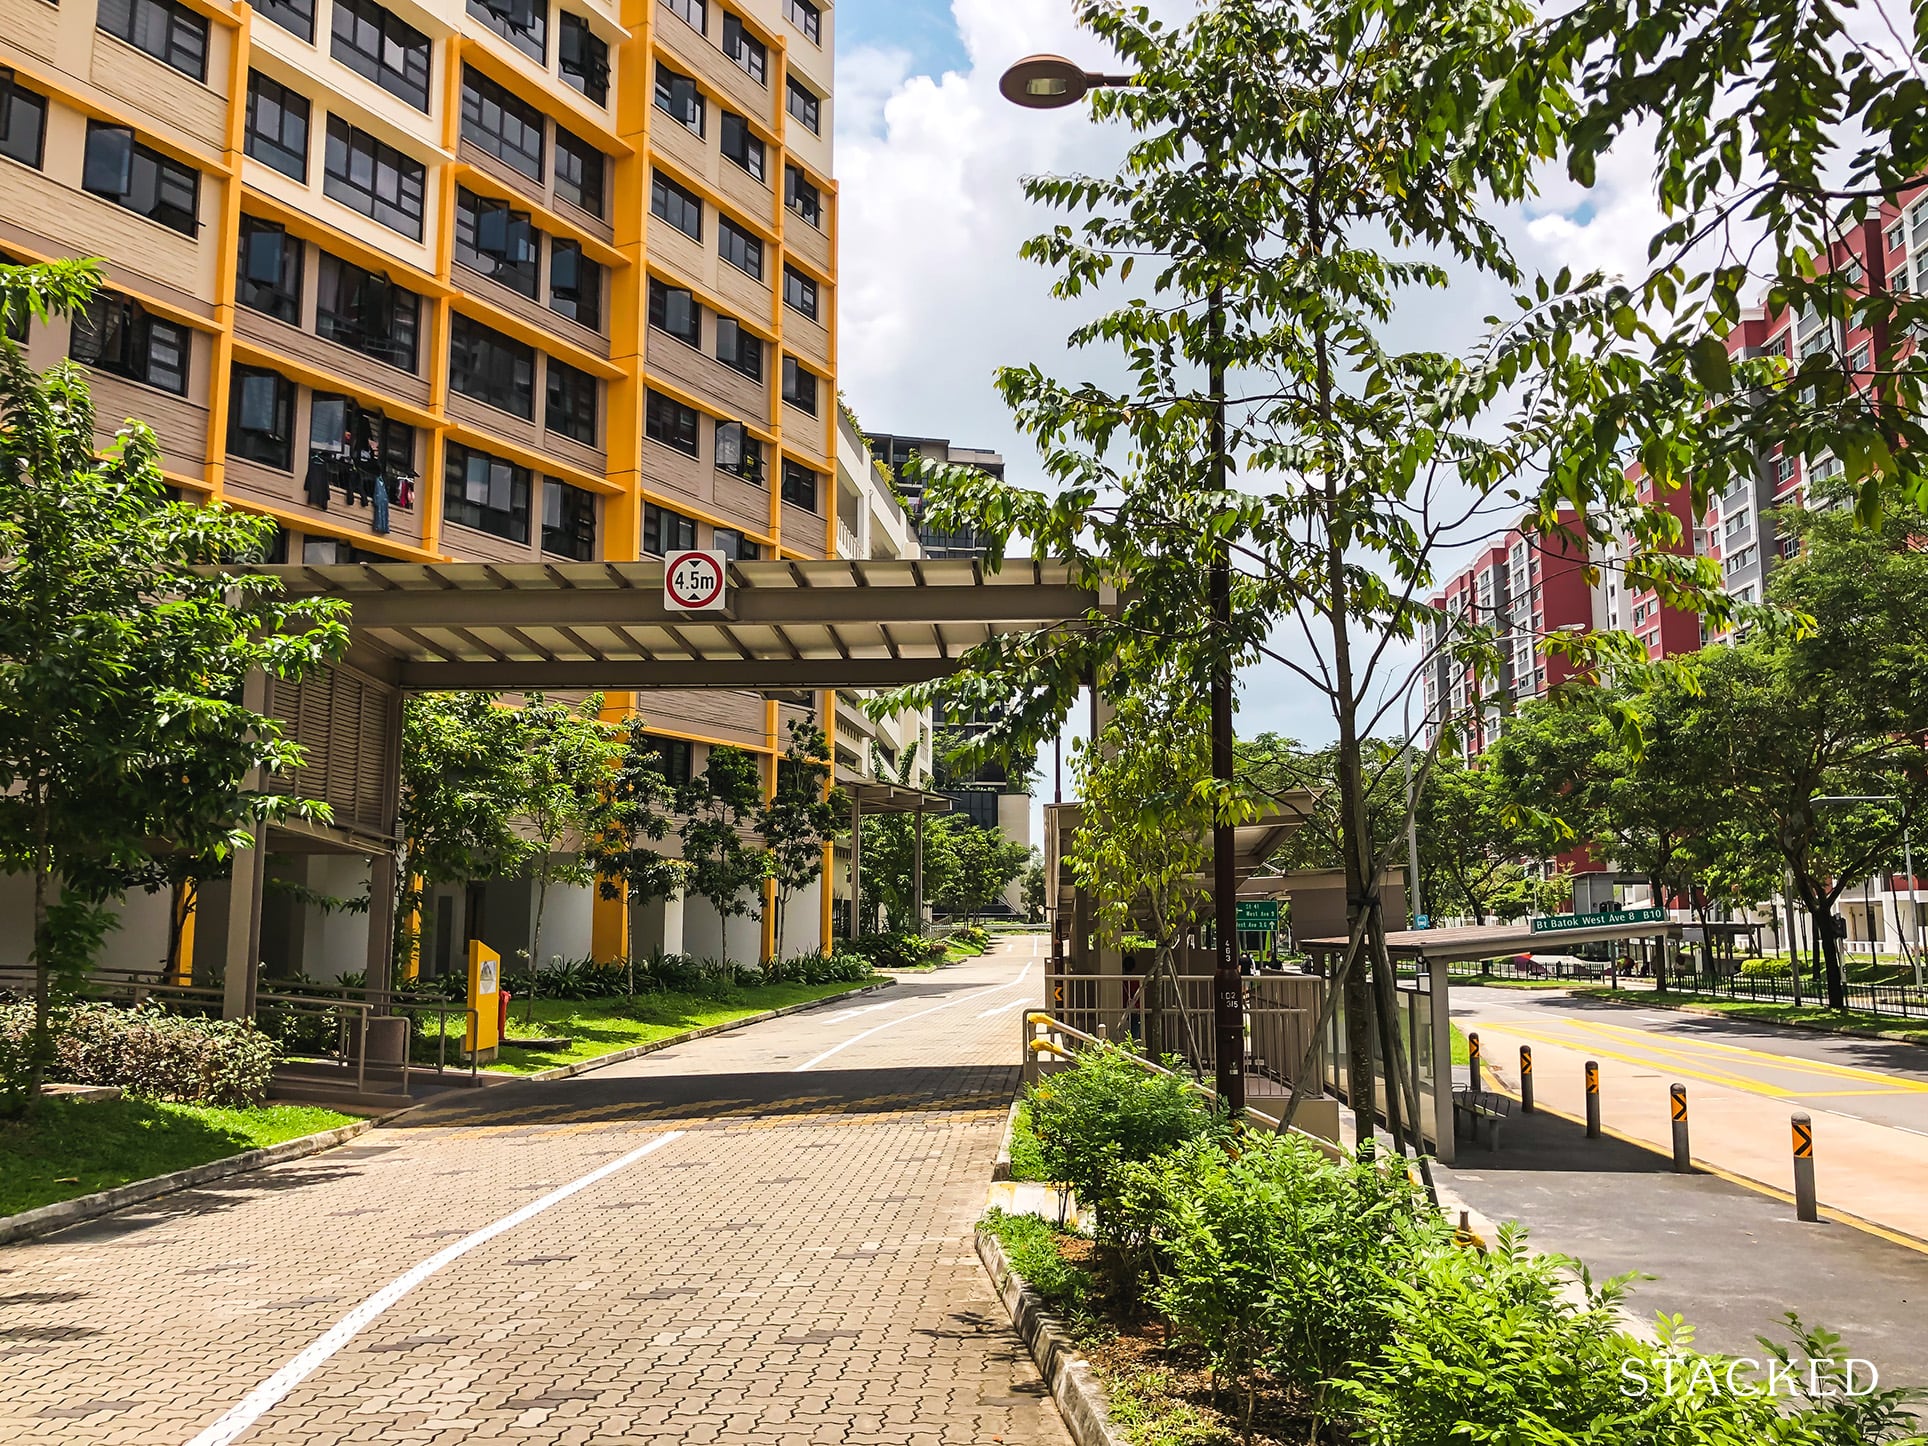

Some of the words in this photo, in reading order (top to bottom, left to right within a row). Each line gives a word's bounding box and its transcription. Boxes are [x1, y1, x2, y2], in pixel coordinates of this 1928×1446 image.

[674, 571, 714, 590] 4.5m
[1536, 920, 1548, 930] Bt
[1551, 917, 1579, 929] Batok
[1582, 915, 1606, 925] West
[1608, 913, 1626, 923] Ave
[1628, 912, 1636, 920] 8
[1643, 909, 1662, 920] B10
